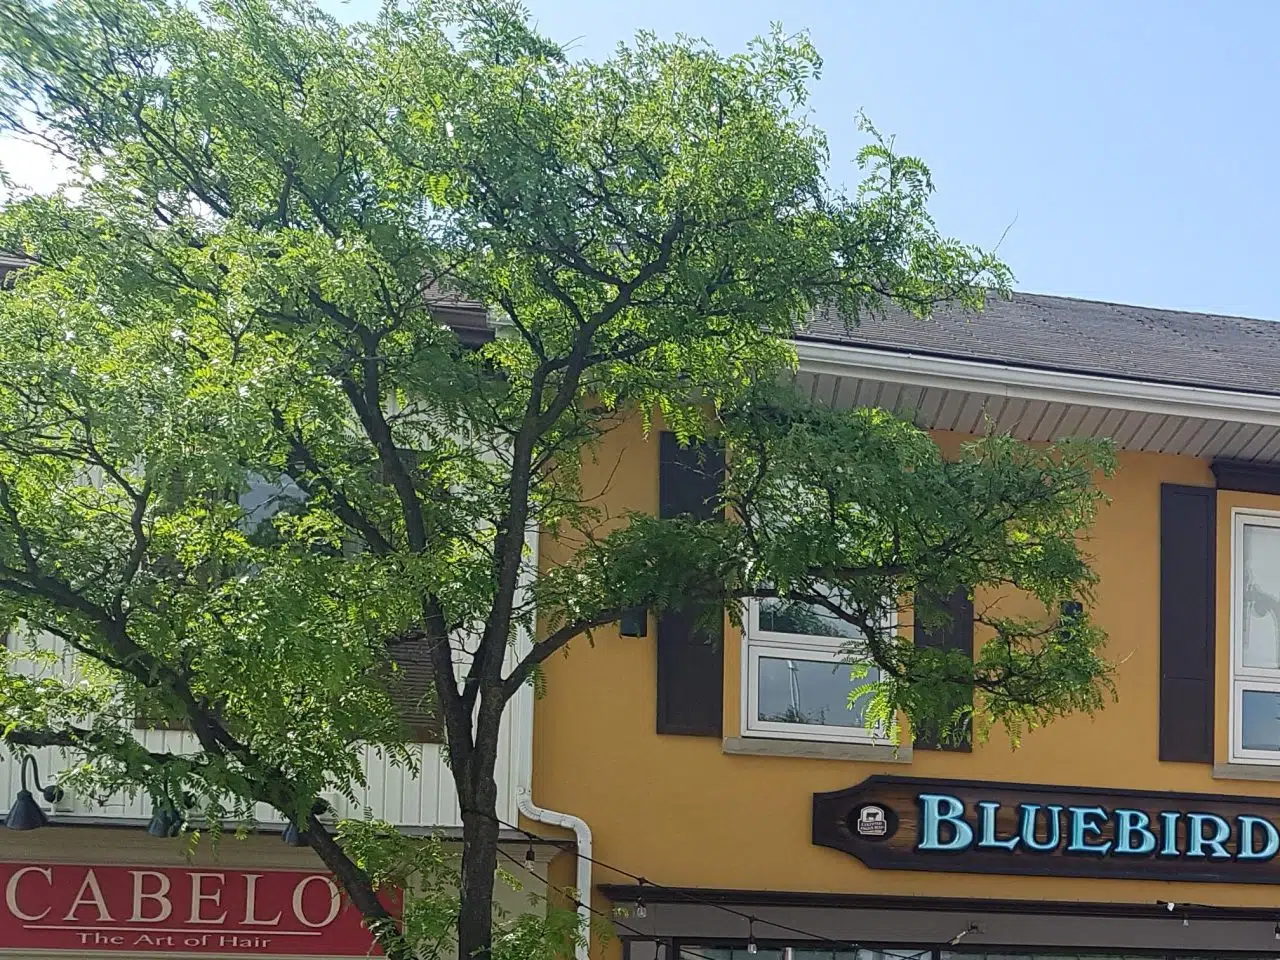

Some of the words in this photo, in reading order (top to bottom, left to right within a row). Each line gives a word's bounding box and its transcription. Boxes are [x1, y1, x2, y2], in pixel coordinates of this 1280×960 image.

[918, 794, 1280, 860] BLUEBIRD
[5, 866, 341, 928] CABELO
[76, 932, 124, 946] The
[136, 934, 173, 947] Art
[183, 934, 209, 948] of
[219, 935, 272, 949] Hair
